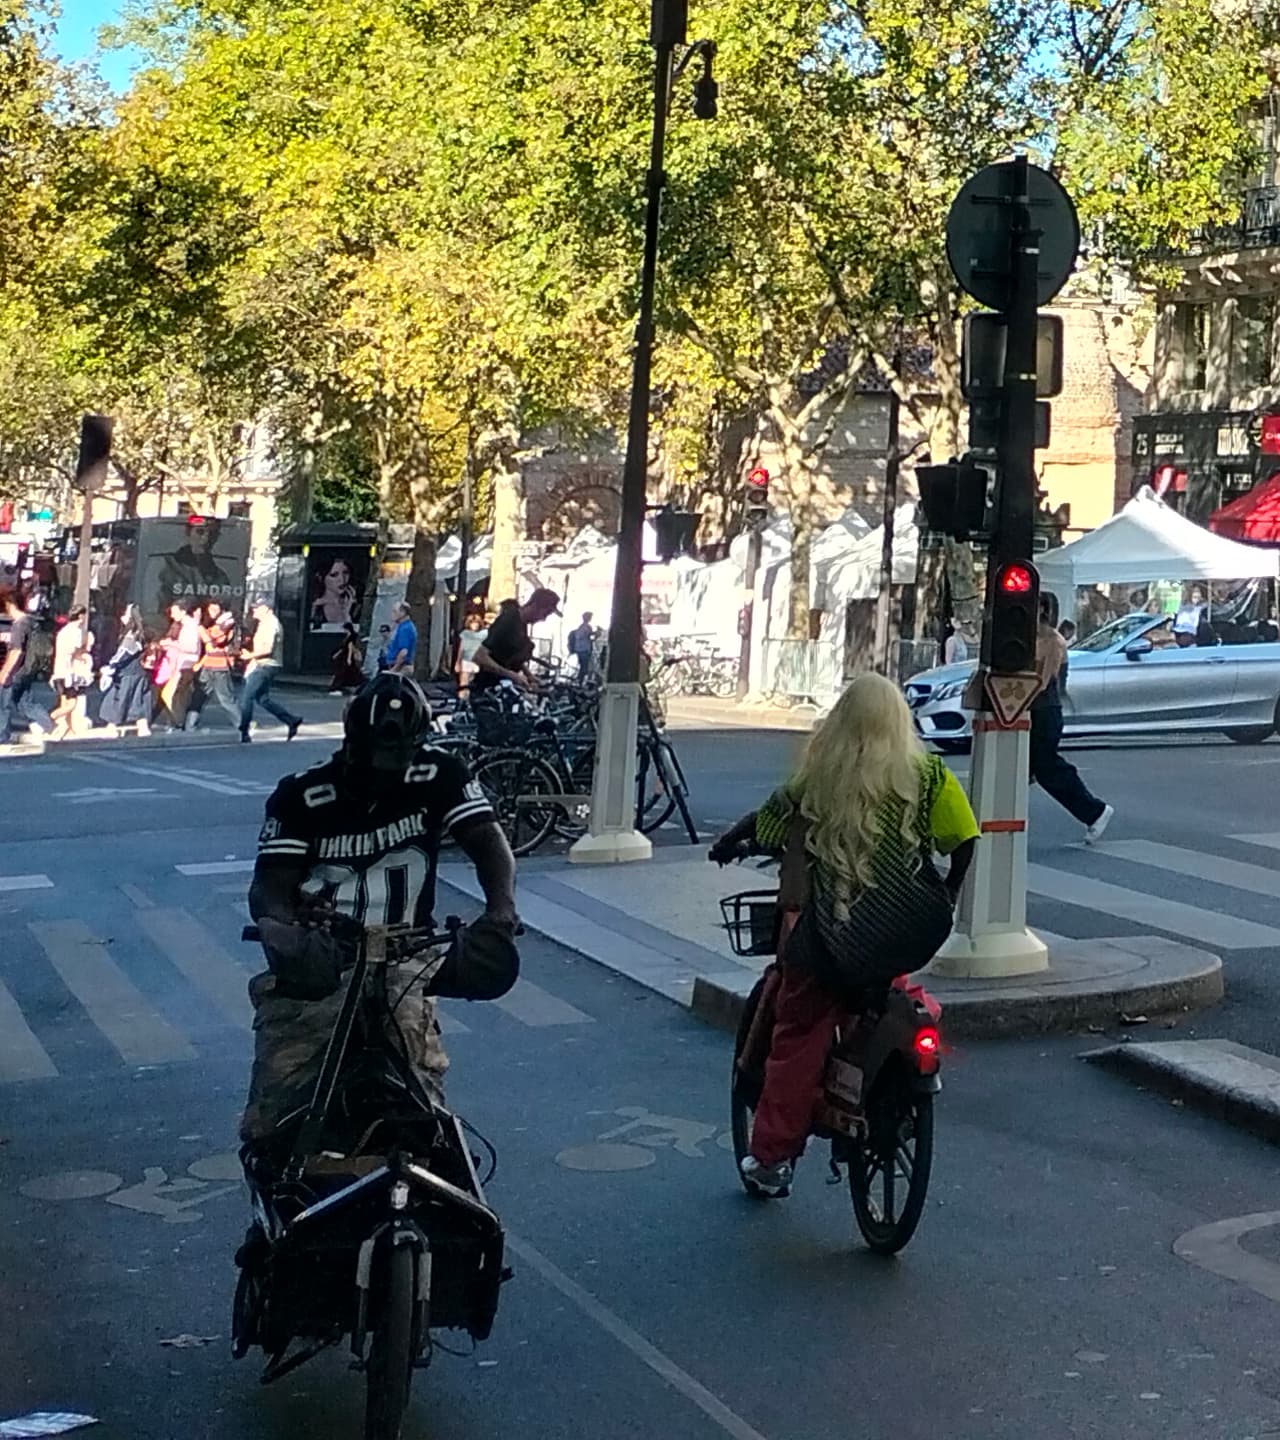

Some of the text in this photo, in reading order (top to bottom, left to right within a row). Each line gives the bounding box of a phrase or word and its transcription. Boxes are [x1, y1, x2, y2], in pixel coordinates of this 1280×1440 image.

[172, 583, 244, 596] SANDRO
[318, 812, 427, 859] INKIN PARK
